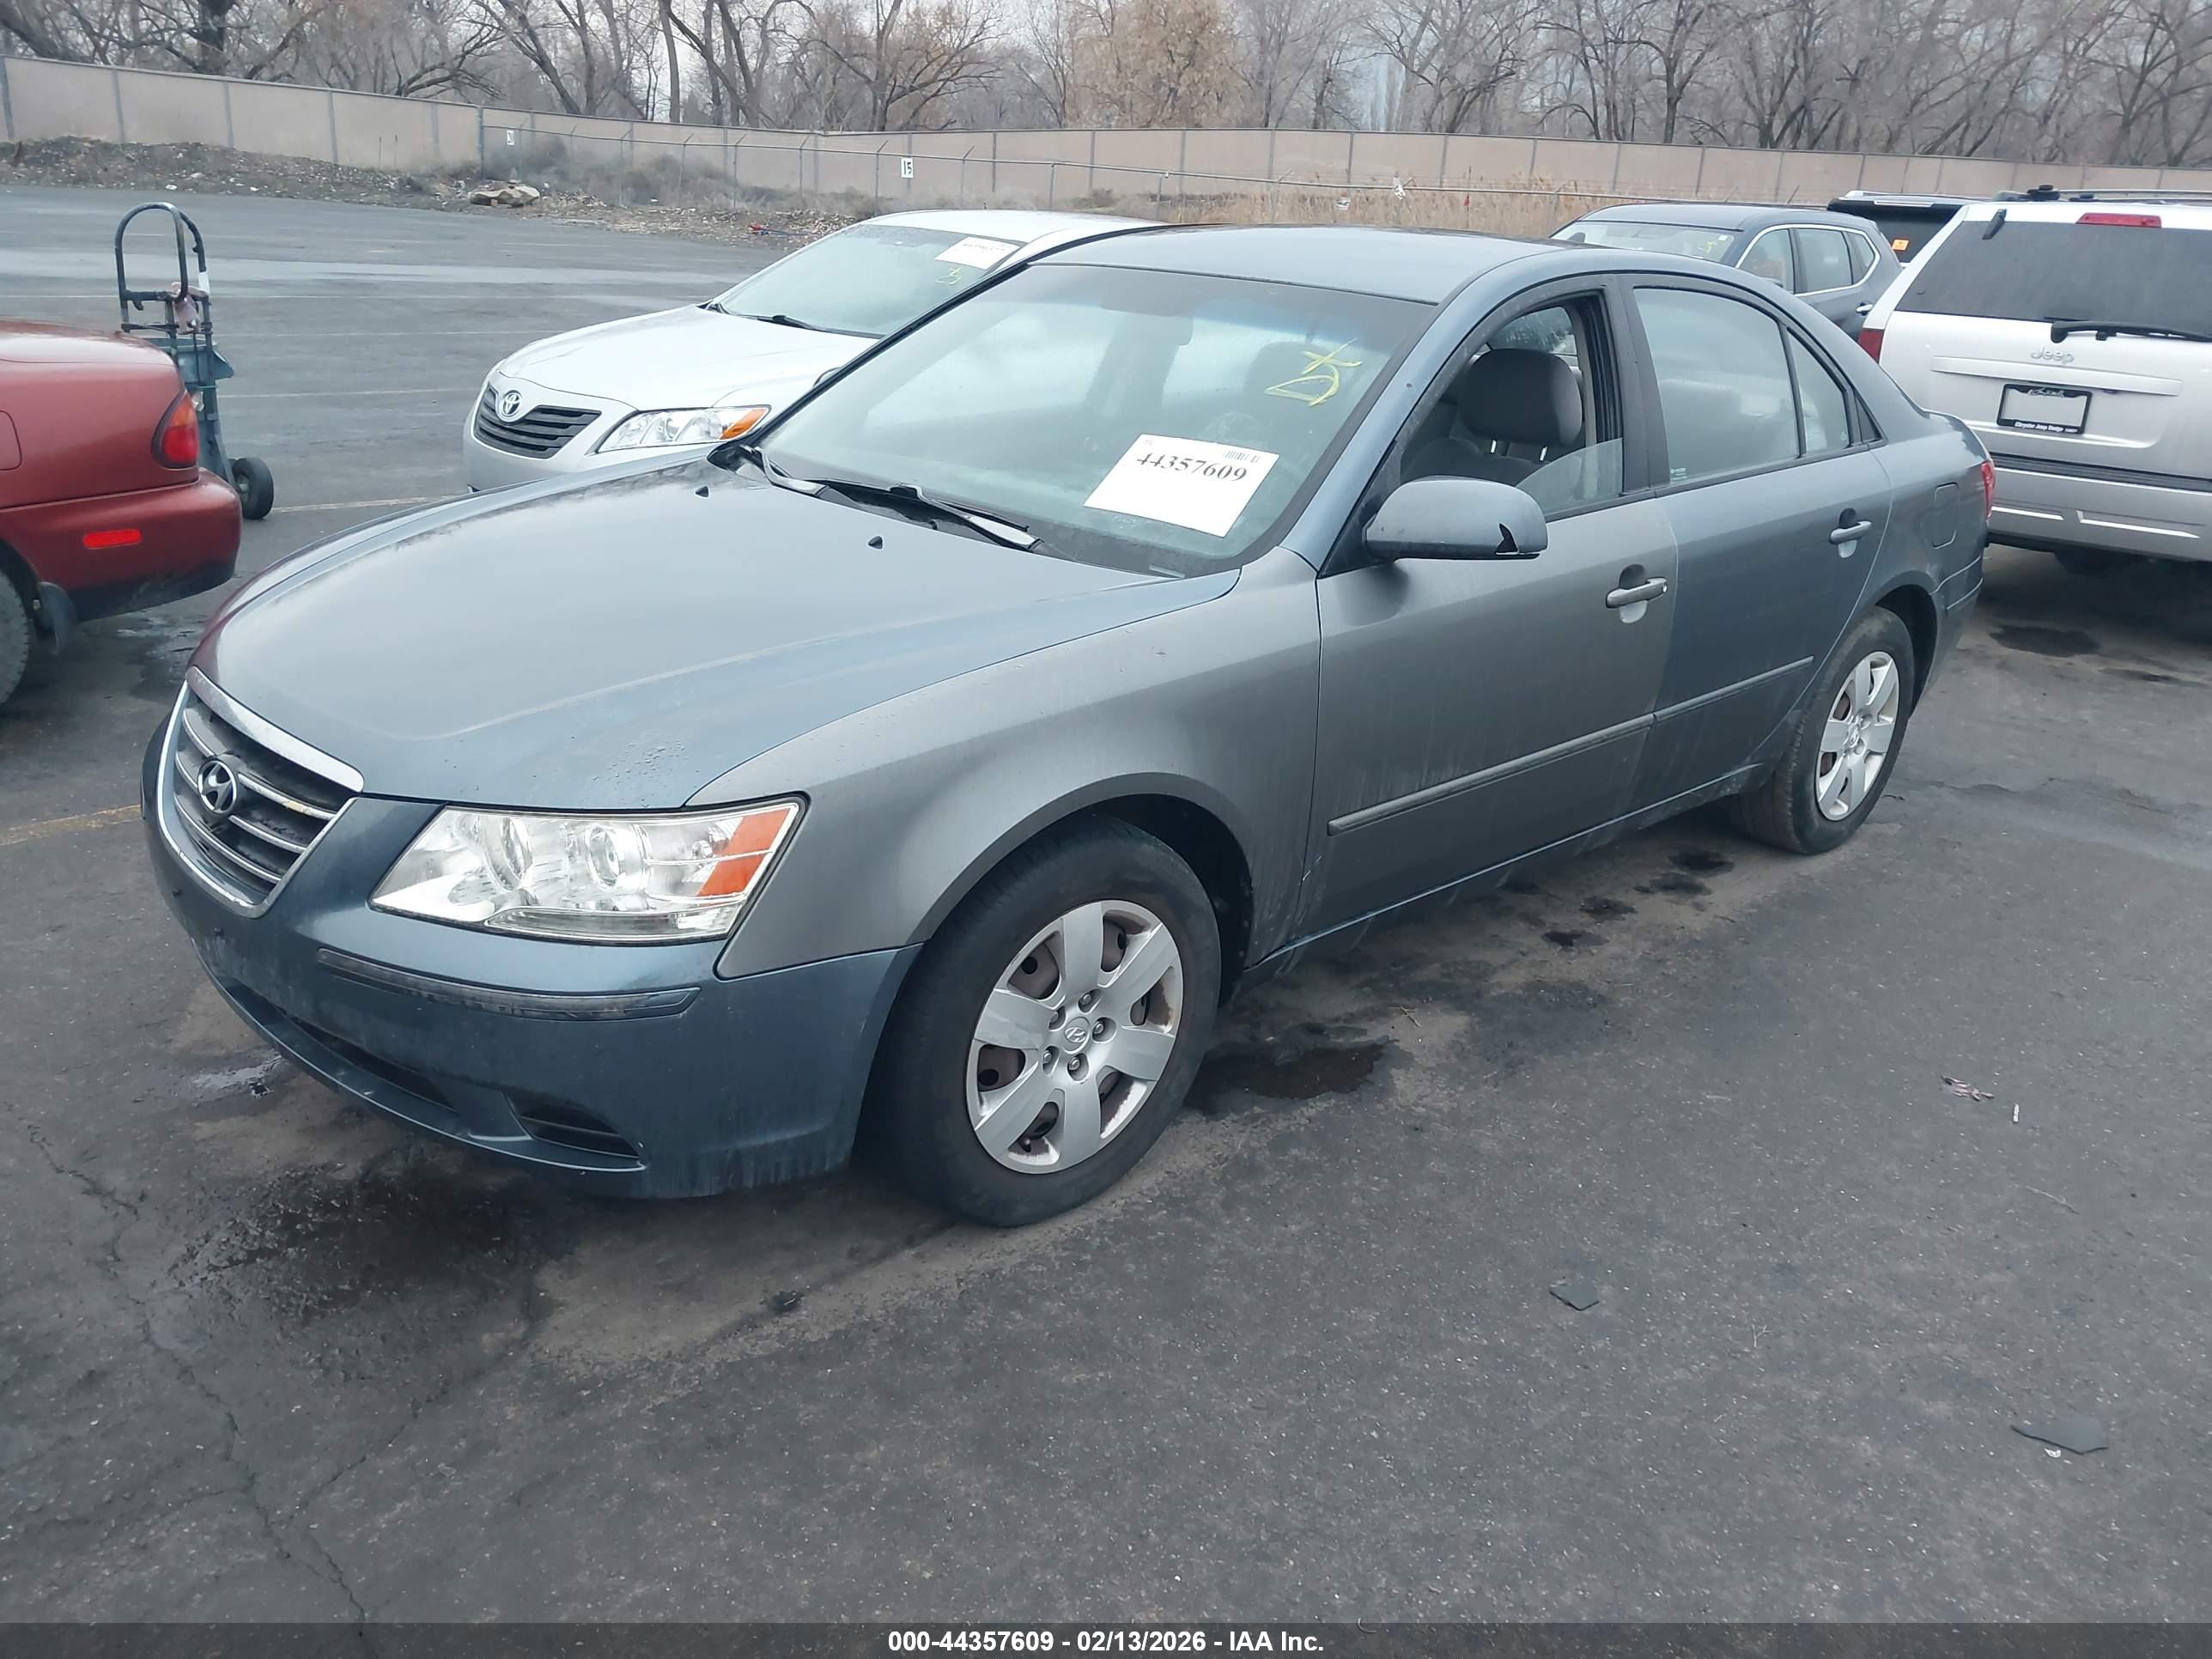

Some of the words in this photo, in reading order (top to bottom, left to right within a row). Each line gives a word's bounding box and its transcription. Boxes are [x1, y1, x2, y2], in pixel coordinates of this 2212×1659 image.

[903, 160, 912, 175] 15
[2030, 346, 2075, 365] Jeep
[1136, 453, 1248, 482] 44357609
